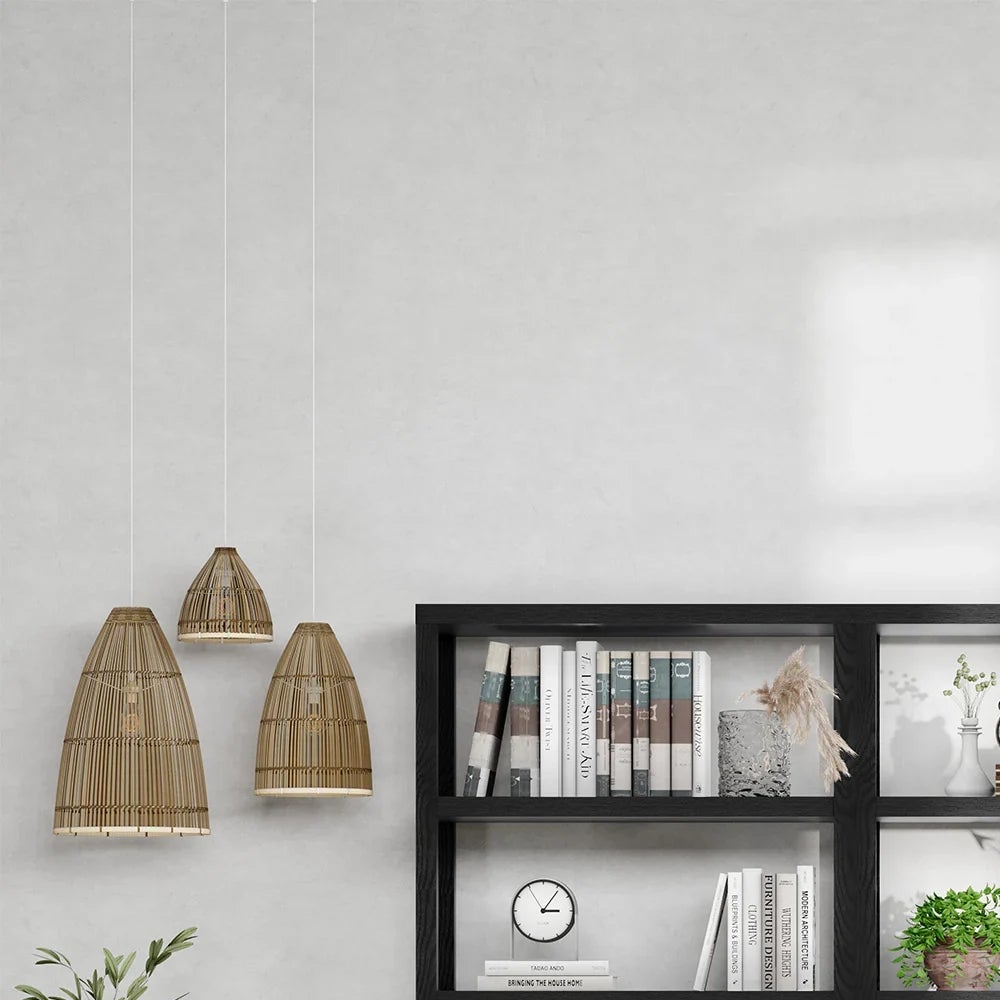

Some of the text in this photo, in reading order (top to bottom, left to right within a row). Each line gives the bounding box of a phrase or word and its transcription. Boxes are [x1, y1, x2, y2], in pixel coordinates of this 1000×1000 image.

[748, 904, 757, 946] CLOTHING
[764, 875, 773, 990] FURNITURE DESIGN
[781, 908, 792, 978] WUTHERING HEIGHTS
[801, 920, 809, 970] ARCHITECTURE
